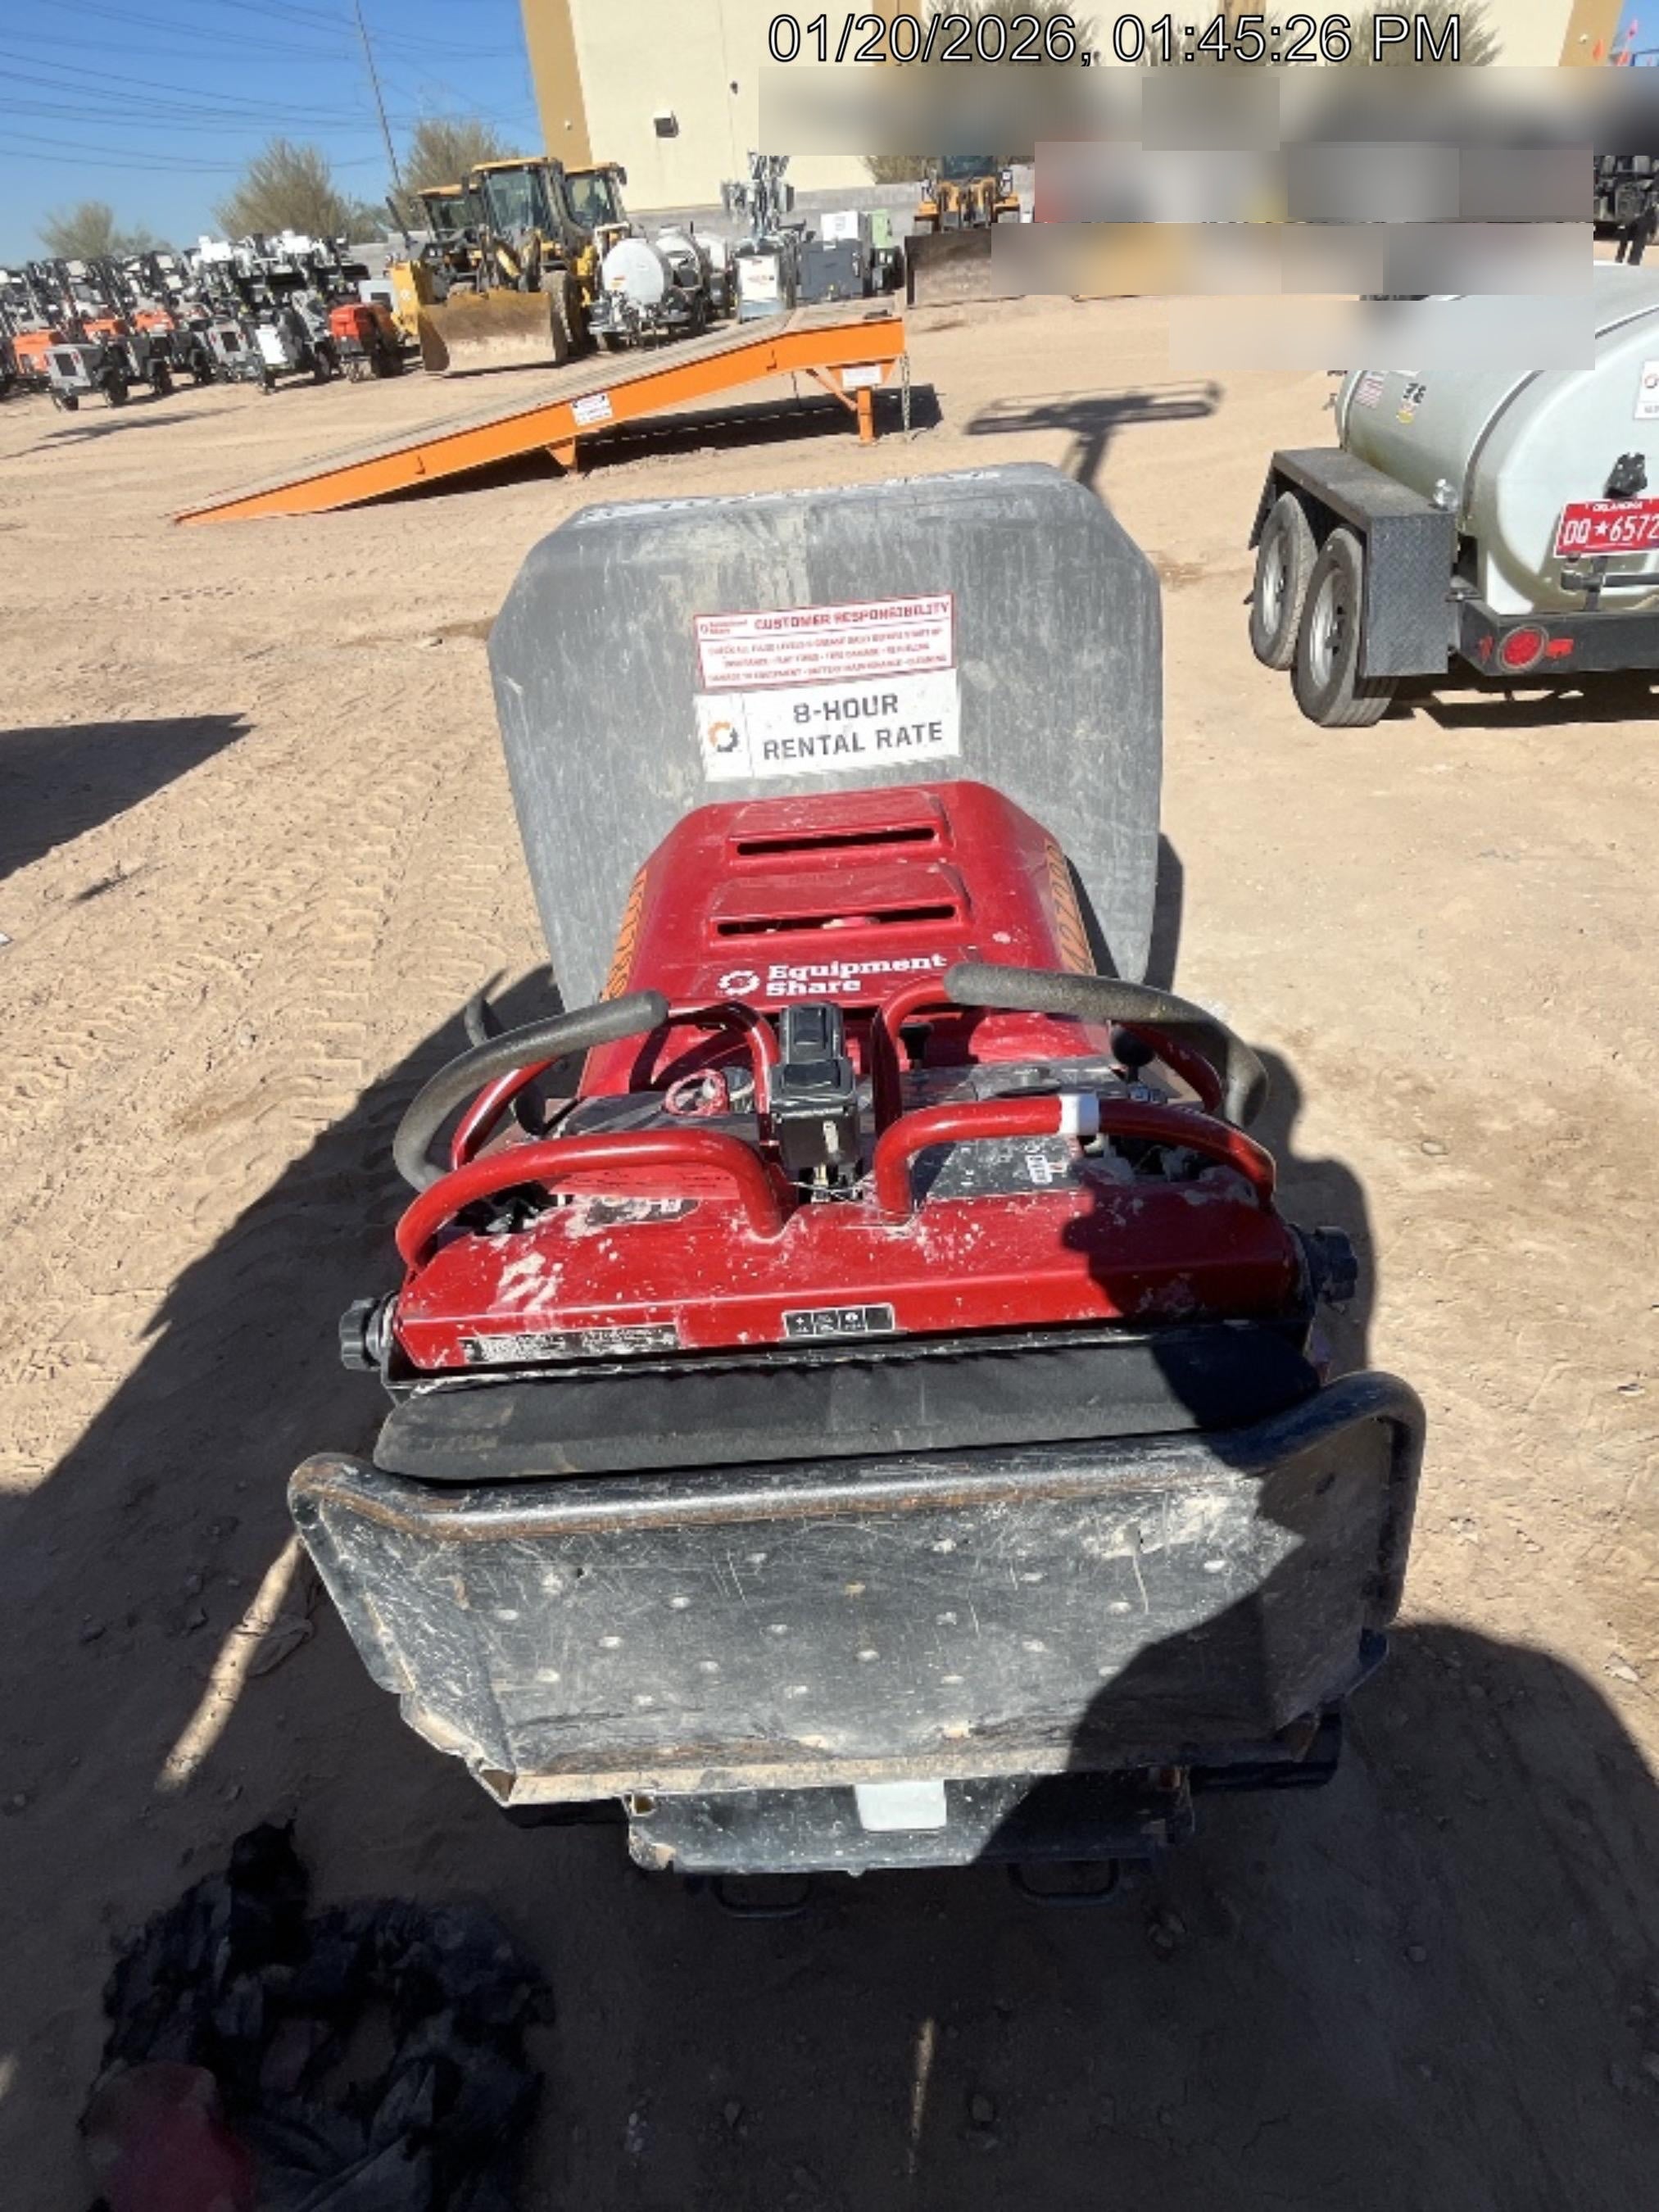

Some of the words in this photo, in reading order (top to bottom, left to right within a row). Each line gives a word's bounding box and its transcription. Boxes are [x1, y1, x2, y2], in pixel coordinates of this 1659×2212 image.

[755, 613, 831, 630] CUSTOMER
[834, 602, 949, 626] RESPONSIBILITY
[793, 694, 899, 723] 8-HOUR
[763, 731, 866, 761] RENTAL
[877, 722, 944, 750] RATE
[768, 954, 947, 981] Equipment
[766, 980, 861, 996] Share
